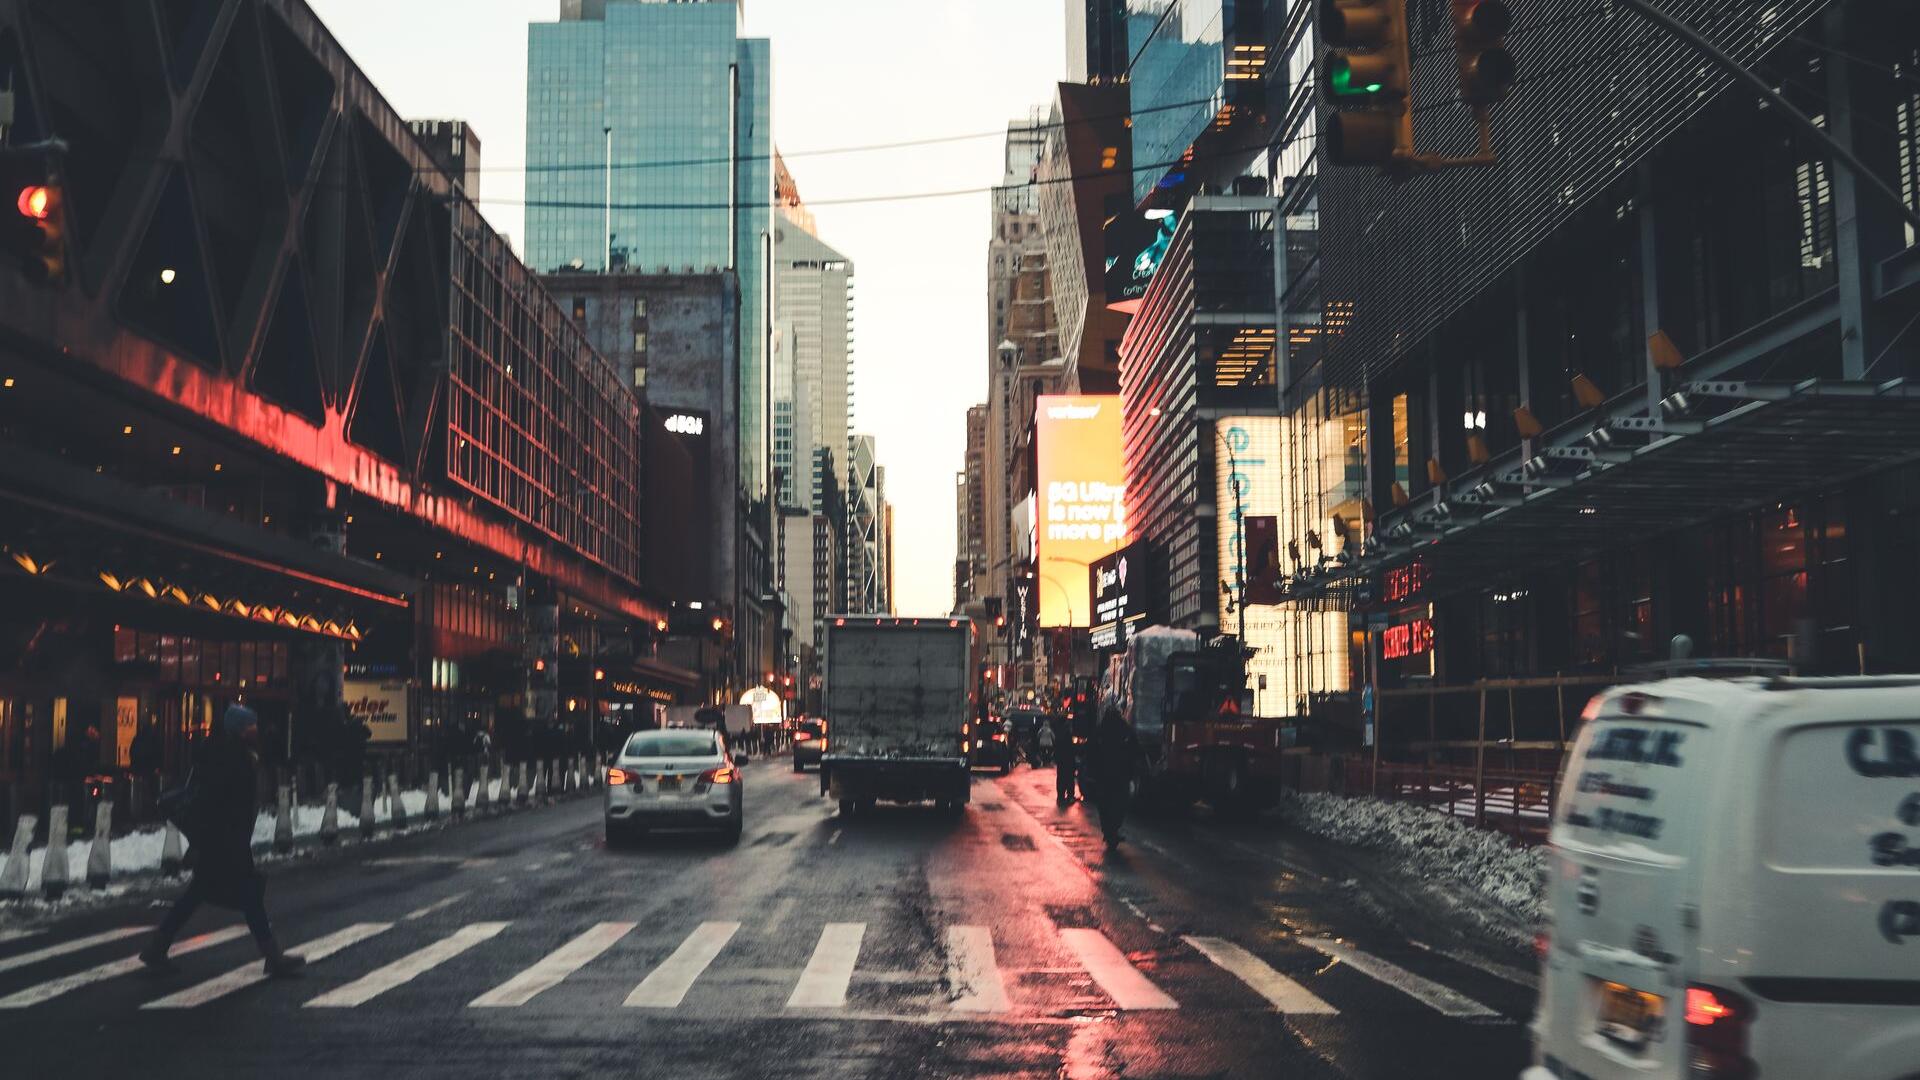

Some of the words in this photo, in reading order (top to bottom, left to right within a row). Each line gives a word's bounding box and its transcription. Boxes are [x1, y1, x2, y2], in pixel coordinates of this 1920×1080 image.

[1047, 404, 1100, 420] verizon
[1048, 501, 1066, 521] is
[1067, 505, 1111, 521] now
[1048, 523, 1102, 540] more
